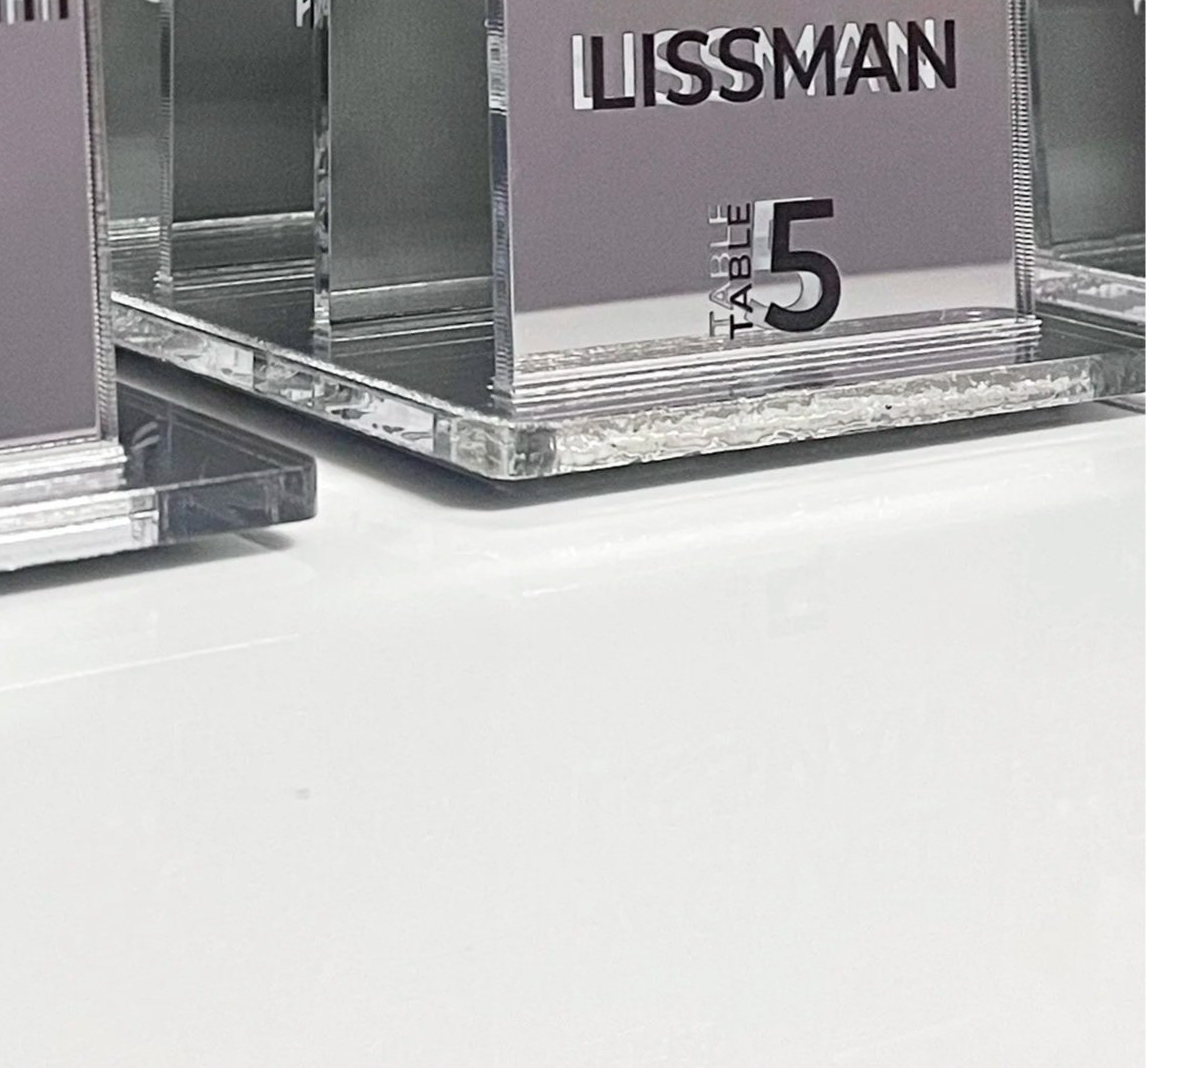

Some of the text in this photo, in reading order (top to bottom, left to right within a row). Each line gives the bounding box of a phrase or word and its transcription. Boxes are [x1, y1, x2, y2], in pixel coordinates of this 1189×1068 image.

[579, 19, 958, 111] LISSMAN
[723, 202, 754, 340] TABLE
[759, 197, 842, 334] 5
